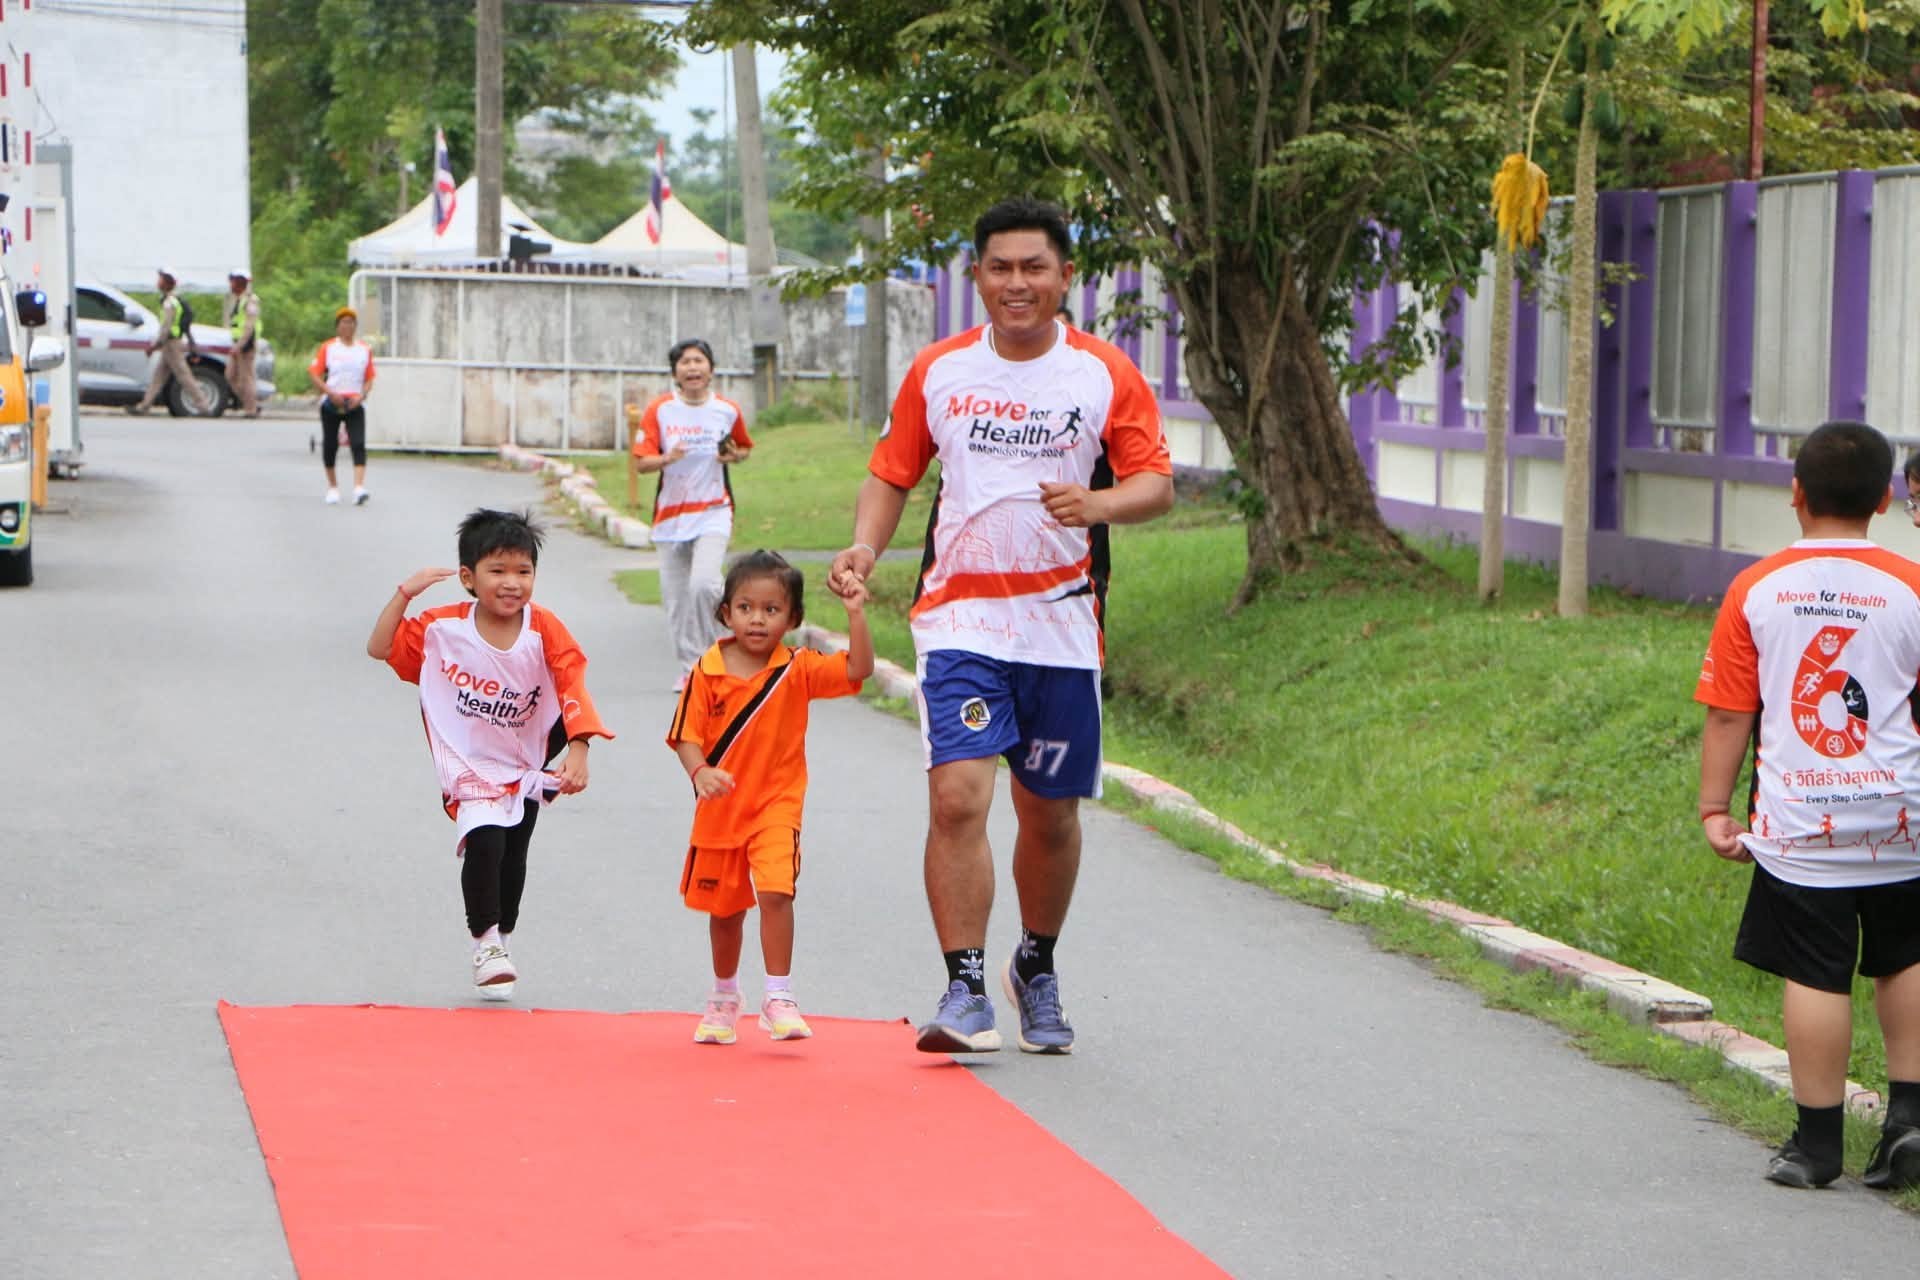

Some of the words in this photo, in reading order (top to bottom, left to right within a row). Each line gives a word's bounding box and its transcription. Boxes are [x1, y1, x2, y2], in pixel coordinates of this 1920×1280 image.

[944, 394, 1027, 421] Move
[1029, 408, 1054, 420] for
[969, 418, 1051, 445] Health
[968, 445, 1019, 458] @Mahidol
[1020, 449, 1038, 459] Day
[1776, 590, 1816, 604] Move
[1819, 590, 1837, 602] for
[1839, 592, 1888, 608] Health
[1846, 608, 1868, 622] Day
[440, 658, 501, 697] Move
[501, 687, 521, 700] for
[1791, 625, 1869, 758] 6
[457, 689, 519, 720] Health
[1783, 771, 1792, 787] 6
[1805, 794, 1829, 806] Every
[1831, 793, 1851, 805] Step
[1853, 791, 1882, 802] Counts
